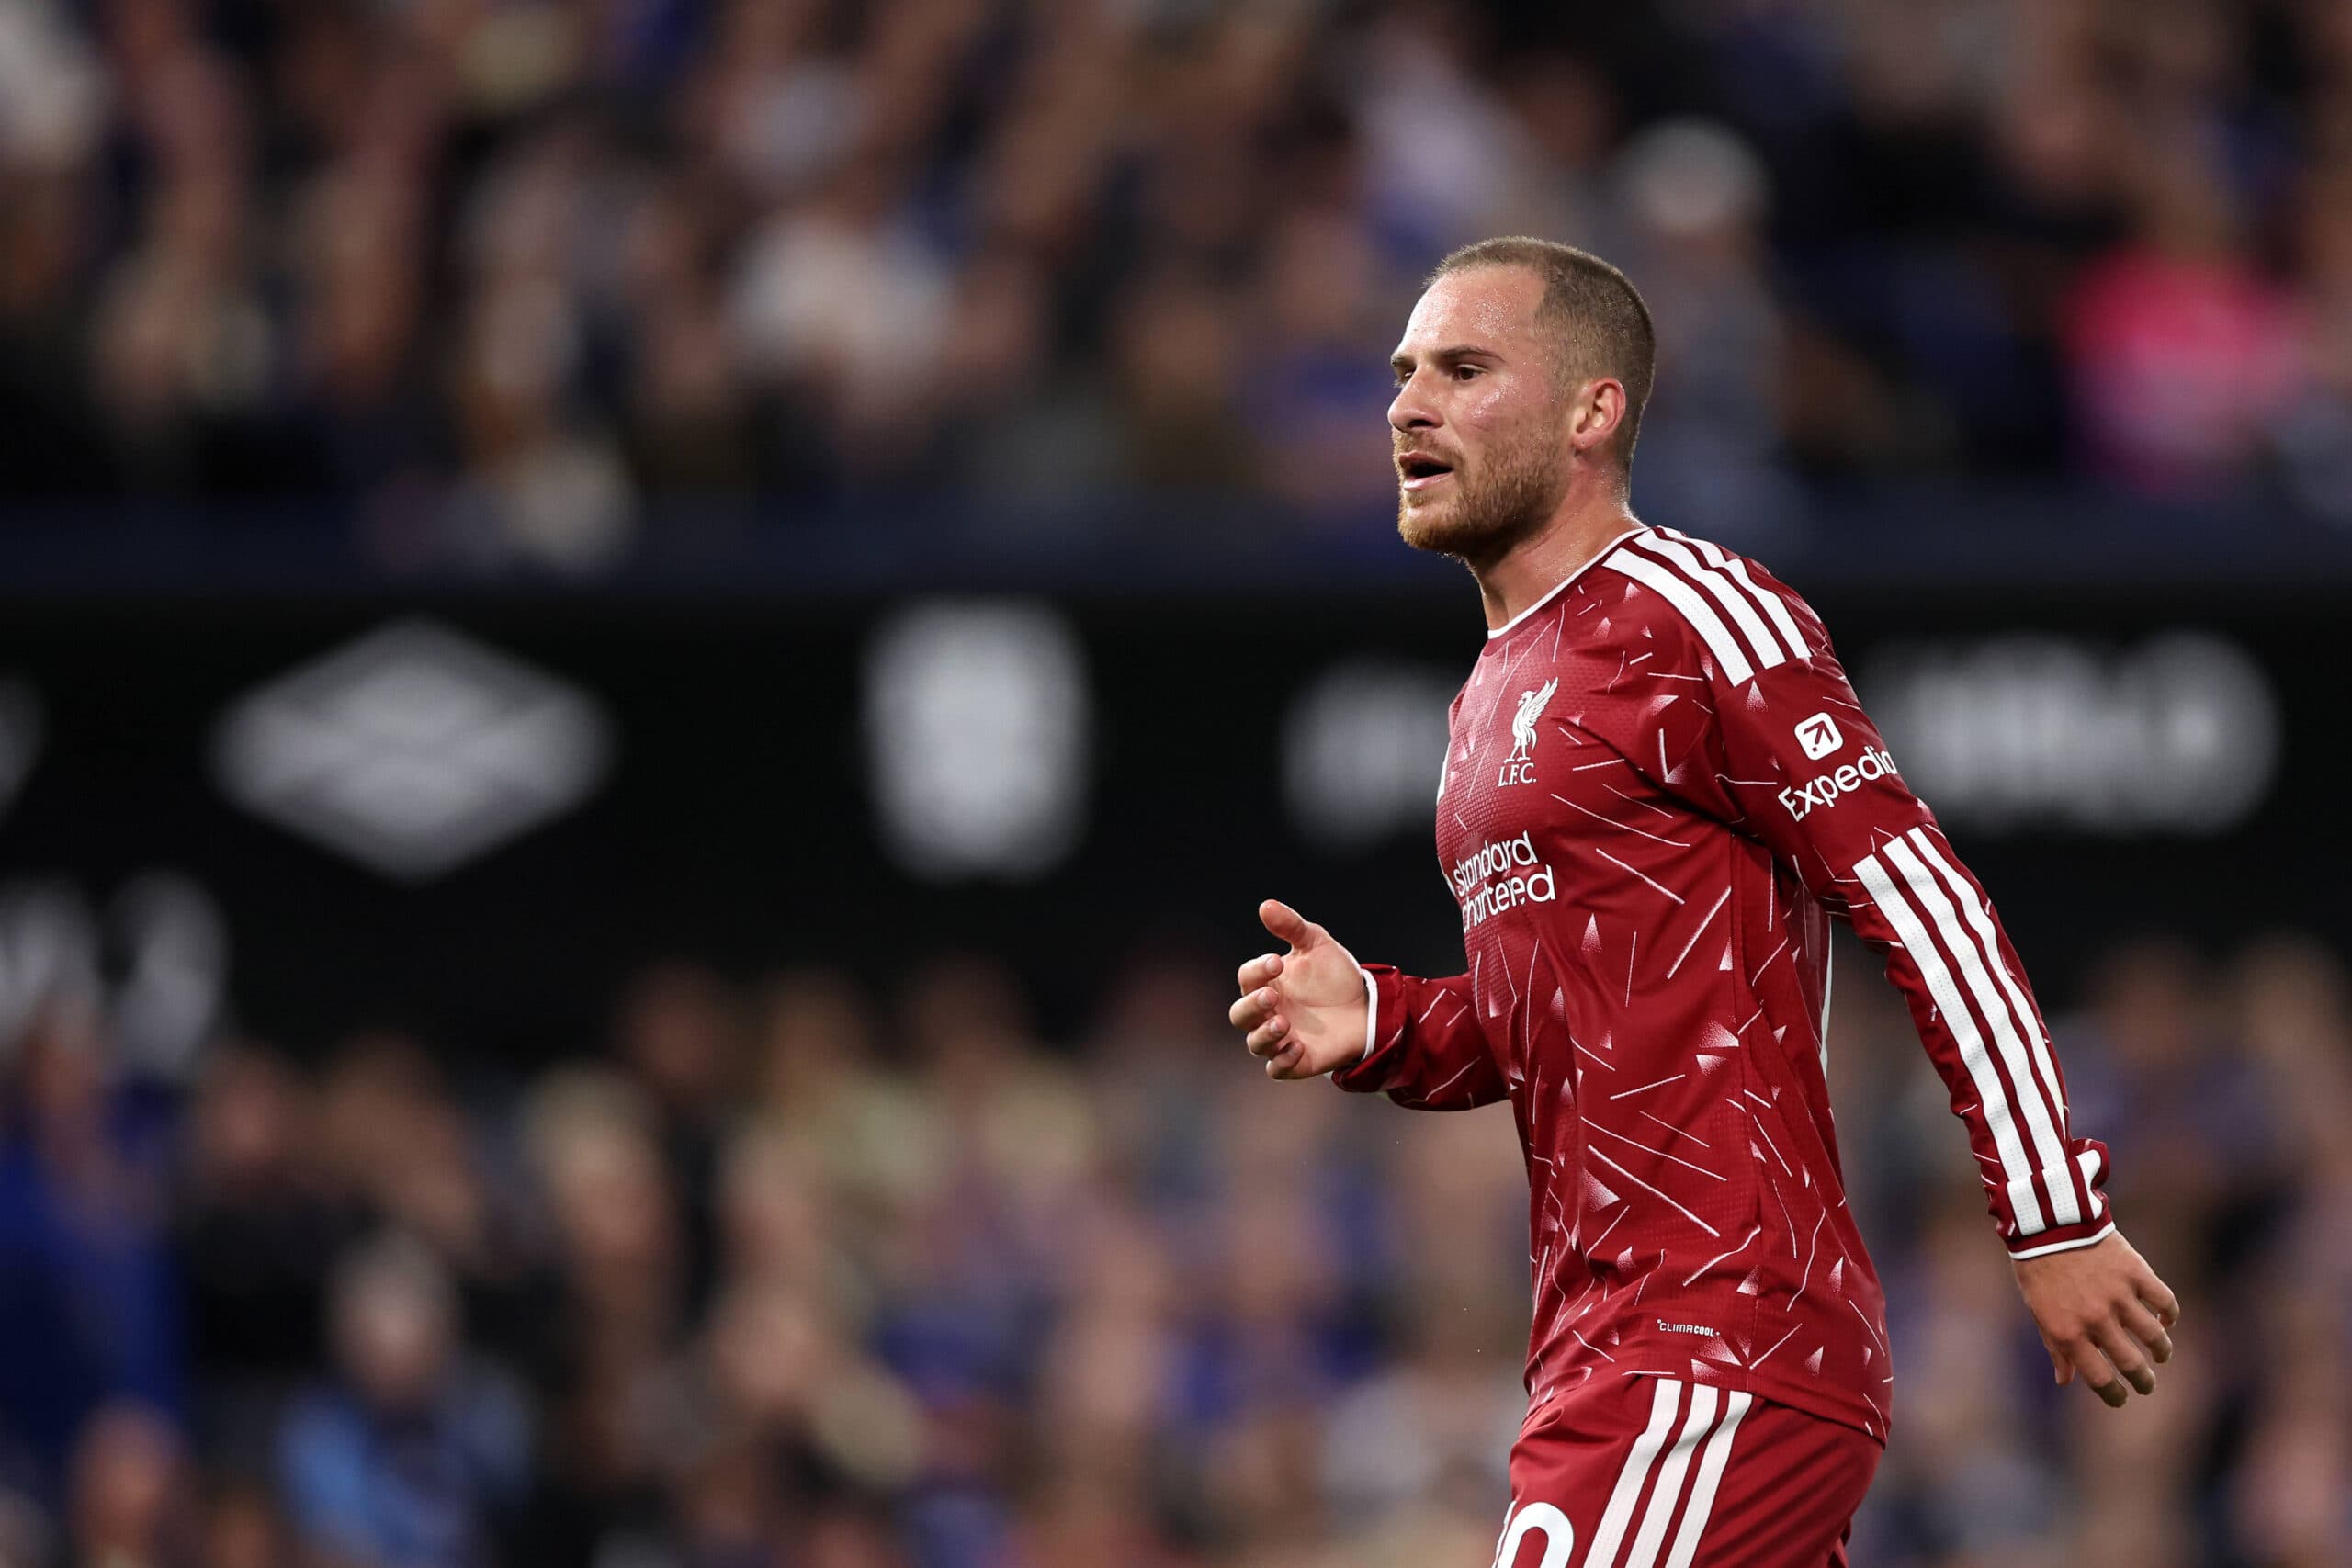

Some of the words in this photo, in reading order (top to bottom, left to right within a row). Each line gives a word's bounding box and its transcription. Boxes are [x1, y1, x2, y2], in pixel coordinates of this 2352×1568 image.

[1778, 745, 1898, 822] Expedia
[1453, 830, 1539, 897] standard
[1462, 864, 1556, 934] chartered
[1659, 1322, 1715, 1337] CLIMACOOL
